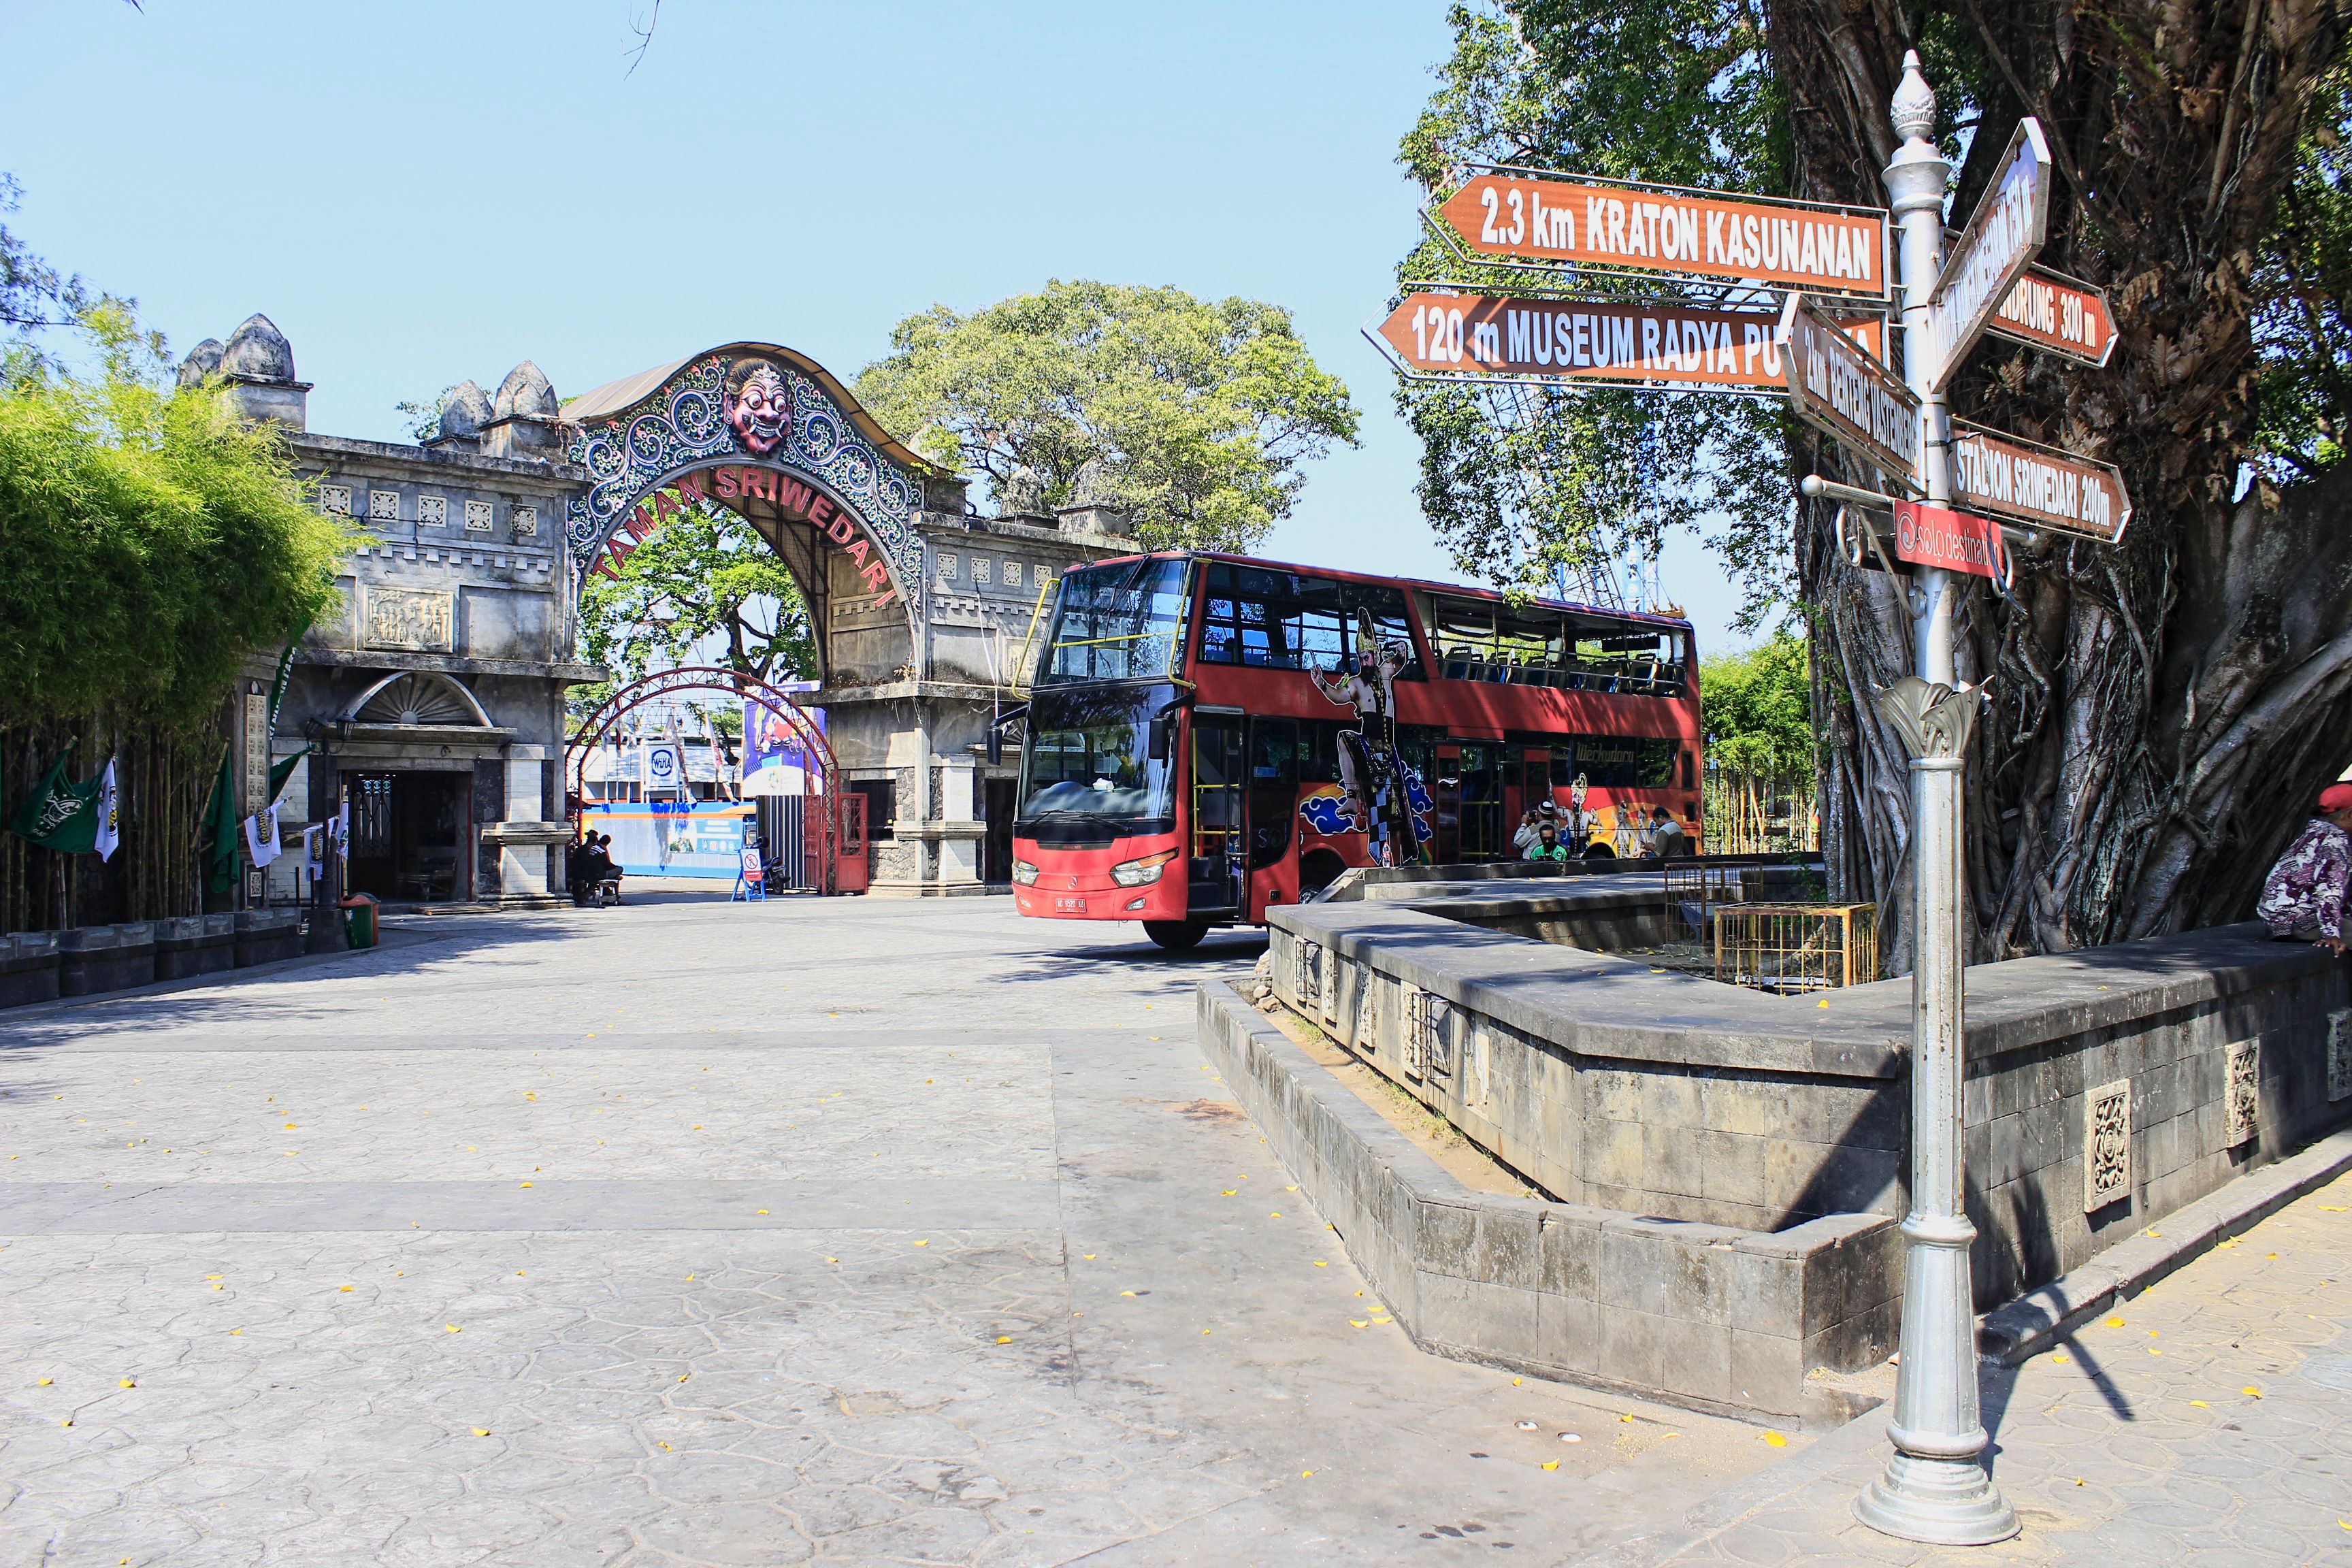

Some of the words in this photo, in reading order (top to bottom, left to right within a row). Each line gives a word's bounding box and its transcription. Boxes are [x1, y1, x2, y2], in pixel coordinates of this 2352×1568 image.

[1480, 186, 1524, 246] 2.3
[1532, 191, 1575, 250] km
[1587, 195, 1699, 263] KRATON
[1707, 209, 1871, 281] KASUNANAN
[1411, 304, 1464, 364] 120
[1474, 322, 1500, 363] m
[1507, 309, 1635, 370] MUSEUM
[1643, 316, 1736, 375] RADYA
[2060, 292, 2082, 344] 300
[2084, 311, 2096, 348] m
[1829, 346, 1871, 435] BENTENG
[1957, 440, 2012, 504] STADION
[2014, 457, 2078, 519] SRIWEDARI
[2081, 474, 2110, 527] 200m
[591, 471, 704, 581] TAMAN
[717, 468, 897, 608] SRIWEDARI
[1946, 523, 2002, 568] destinatin
